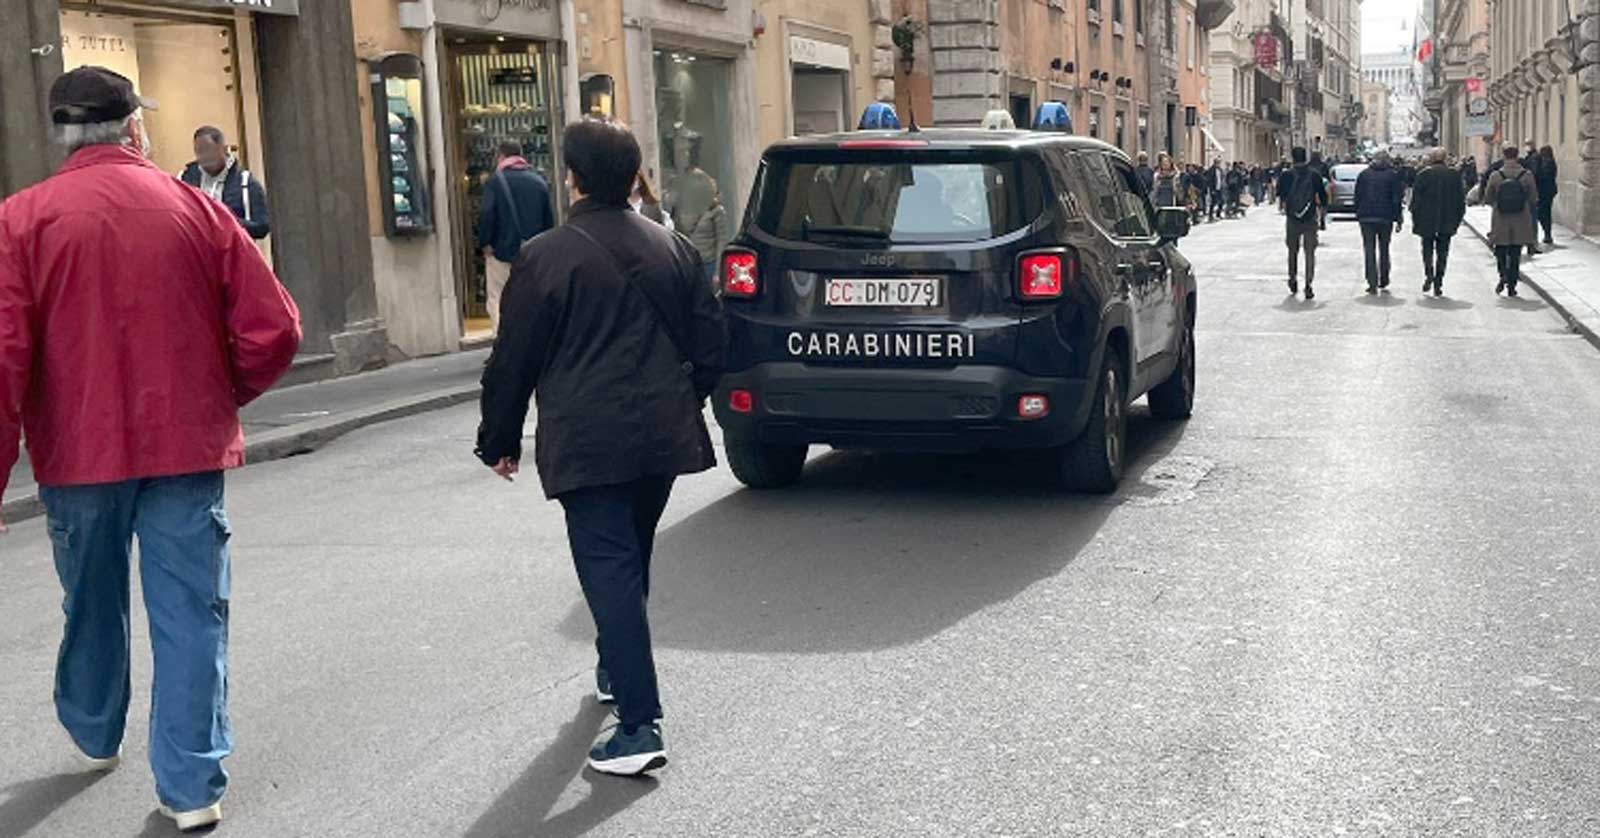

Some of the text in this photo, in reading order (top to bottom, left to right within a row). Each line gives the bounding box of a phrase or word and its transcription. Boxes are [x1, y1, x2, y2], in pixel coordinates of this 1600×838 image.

[861, 252, 896, 267] Jeep
[829, 282, 935, 303] CC DM 079
[787, 332, 975, 357] CARABINIERI
